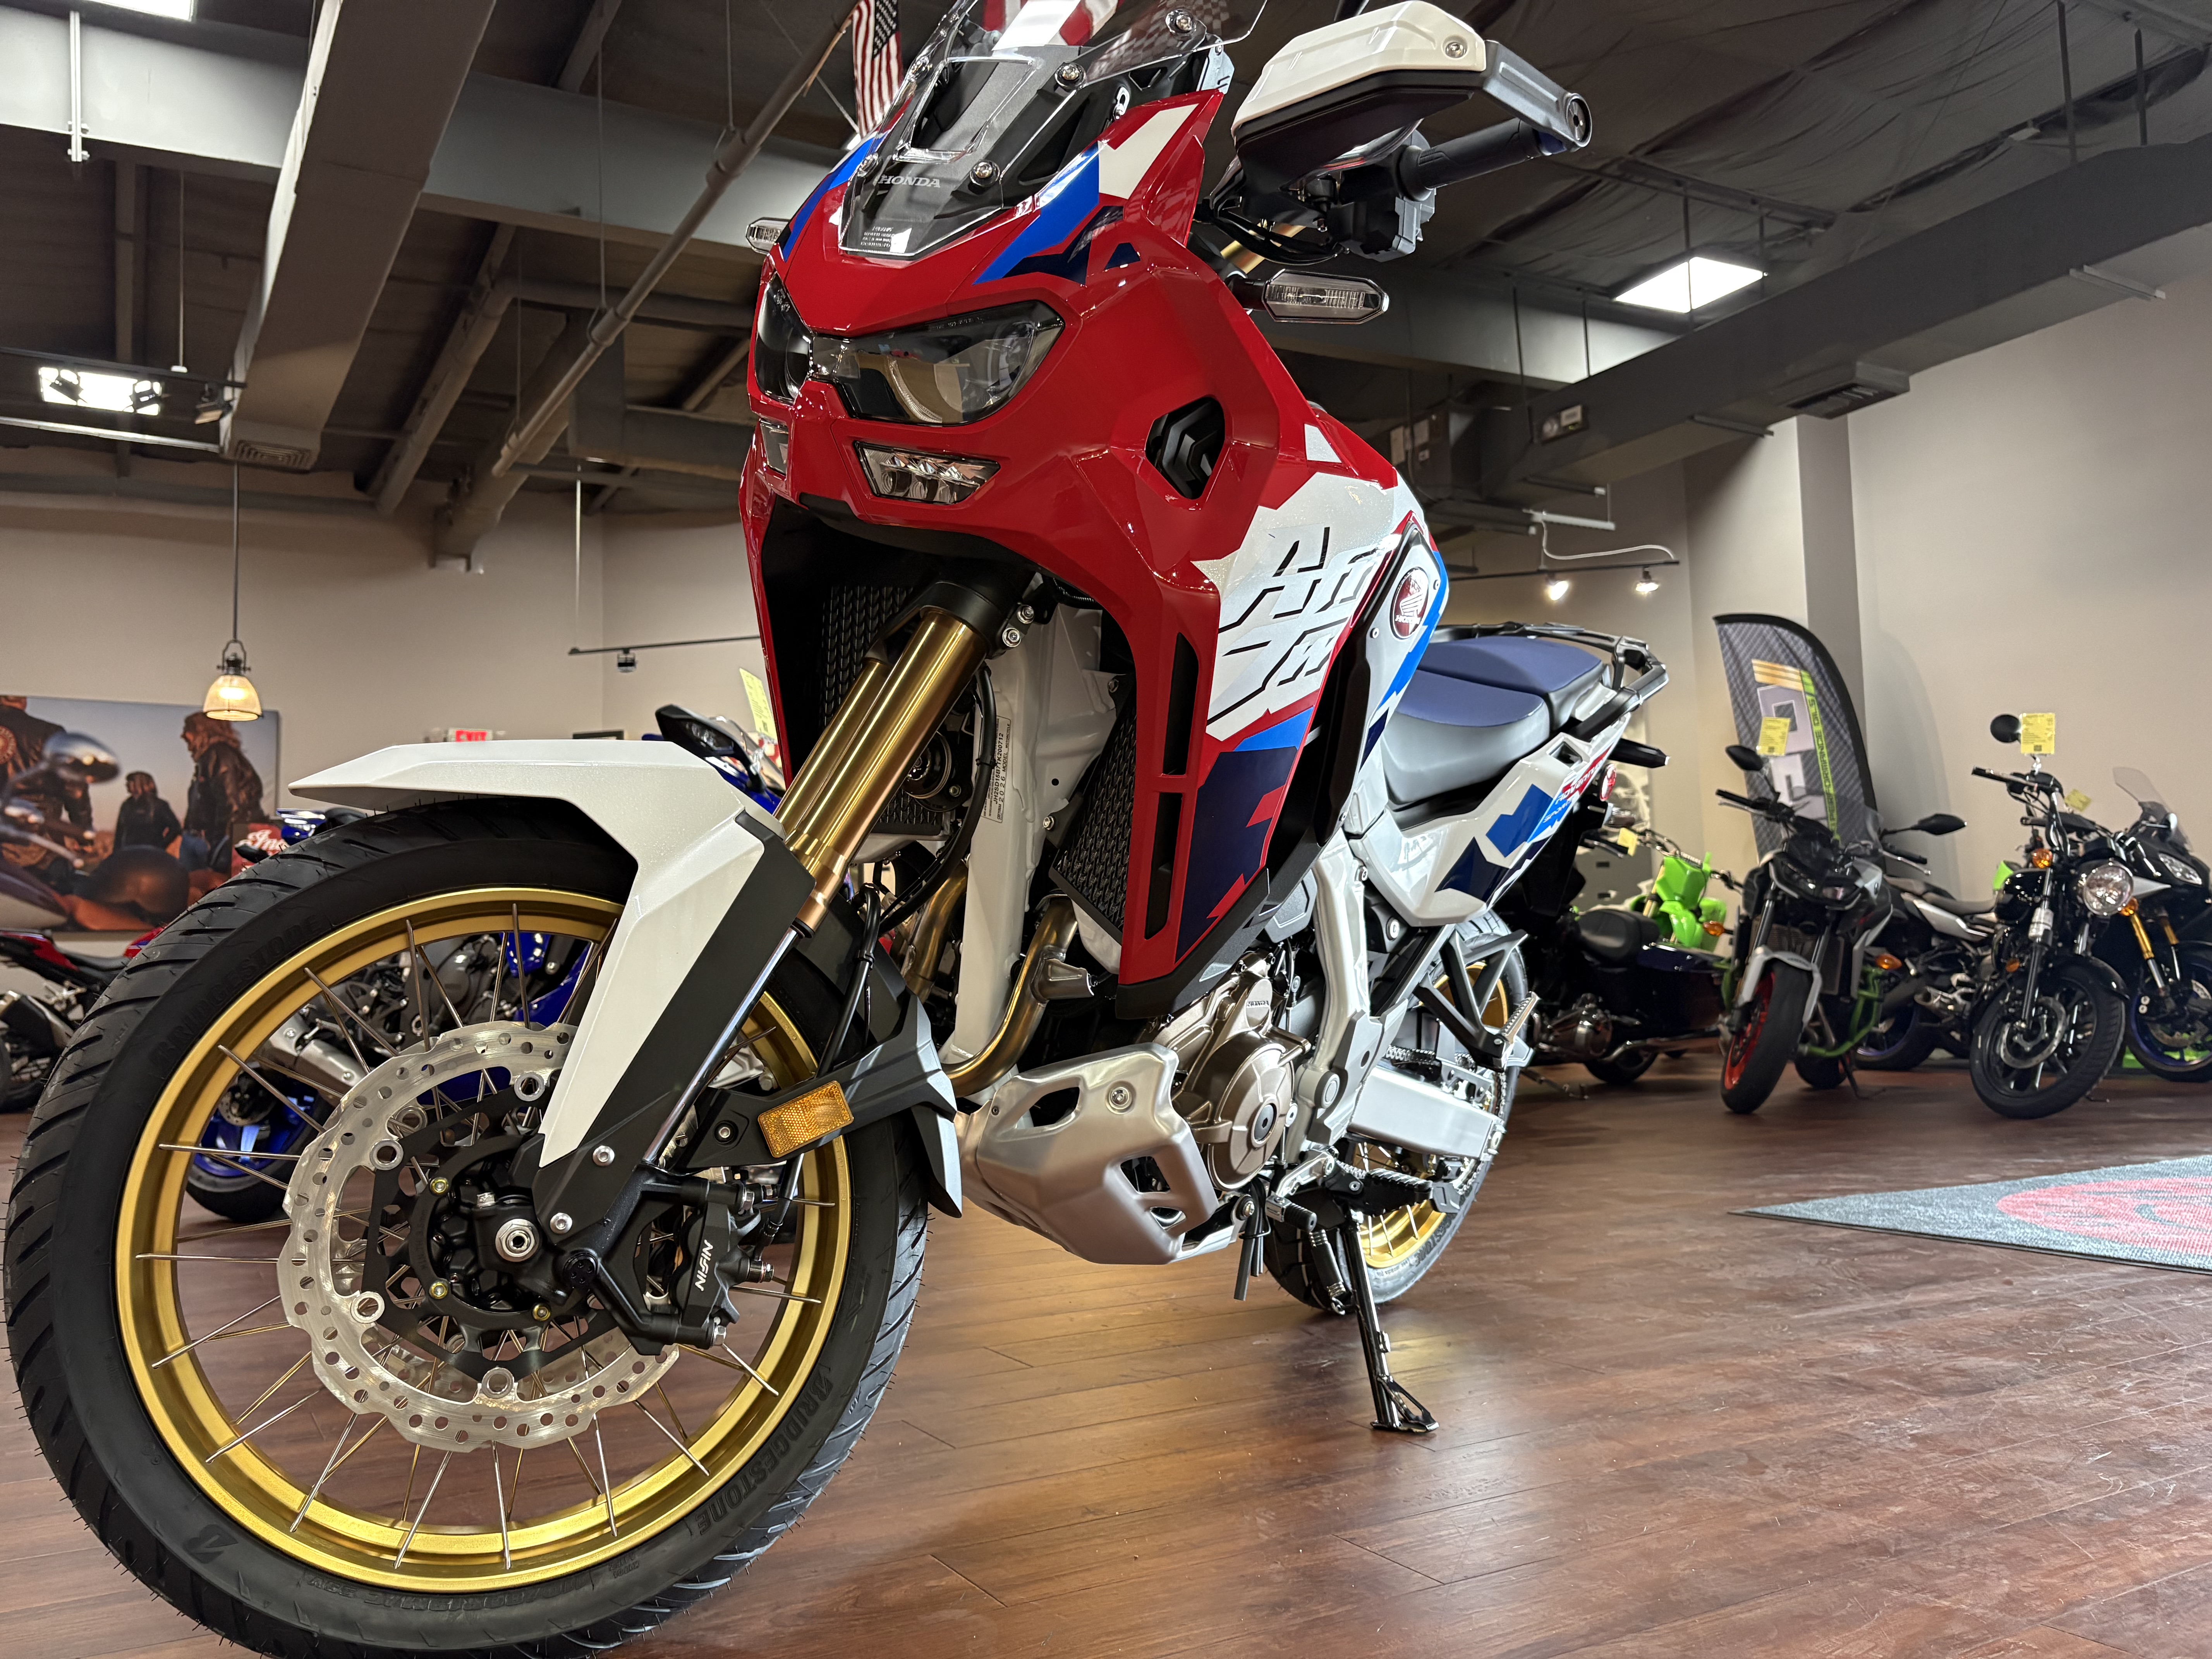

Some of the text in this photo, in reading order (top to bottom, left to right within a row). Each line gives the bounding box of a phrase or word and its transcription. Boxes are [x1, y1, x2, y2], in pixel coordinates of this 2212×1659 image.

[878, 175, 941, 188] HONDA
[1395, 615, 1421, 625] HONDA
[1809, 698, 1820, 725] OILS
[994, 733, 1004, 804] JH2SD15B7TK200712
[695, 1239, 714, 1291] NISSIN
[695, 1371, 833, 1535] BRIDGESTONE
